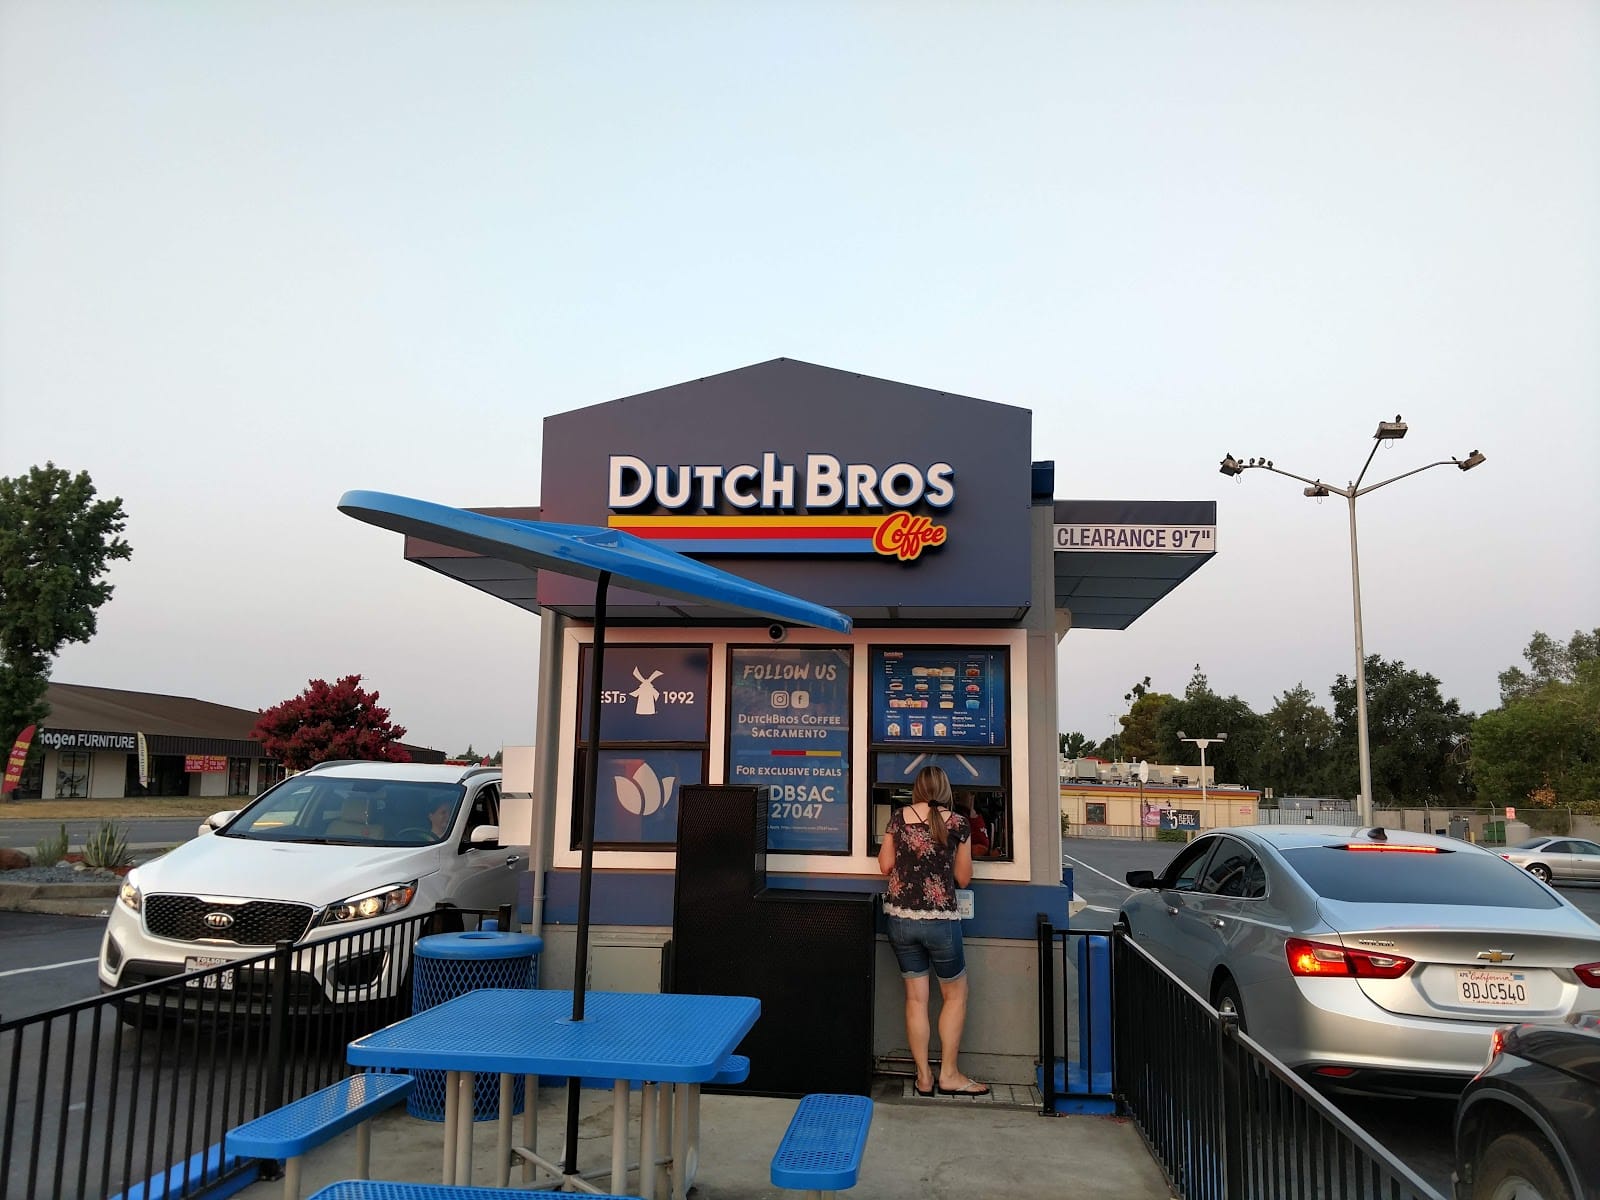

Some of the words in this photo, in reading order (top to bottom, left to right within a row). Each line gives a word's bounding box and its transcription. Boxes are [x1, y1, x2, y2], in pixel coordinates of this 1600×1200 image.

[608, 452, 795, 508] DUTCH
[806, 452, 955, 508] BROS
[876, 512, 945, 558] Coffee
[1057, 527, 1166, 547] CLEARANCE
[1171, 529, 1210, 548] 9'7"
[743, 662, 810, 680] FOLLOW
[815, 663, 837, 681] US
[663, 691, 694, 704] 1992
[801, 714, 841, 725] COFFEE
[78, 733, 135, 748] FURNITURE
[751, 727, 827, 739] SACRAMENTO
[736, 765, 756, 775] FOR
[758, 767, 810, 776] EXCLUSIVE
[813, 768, 842, 776] DEALS
[770, 785, 834, 802] DBSAC
[771, 803, 823, 819] 27047
[207, 915, 228, 926] KIA
[1470, 971, 1510, 983] California
[1462, 982, 1526, 1001] 8DJC540
